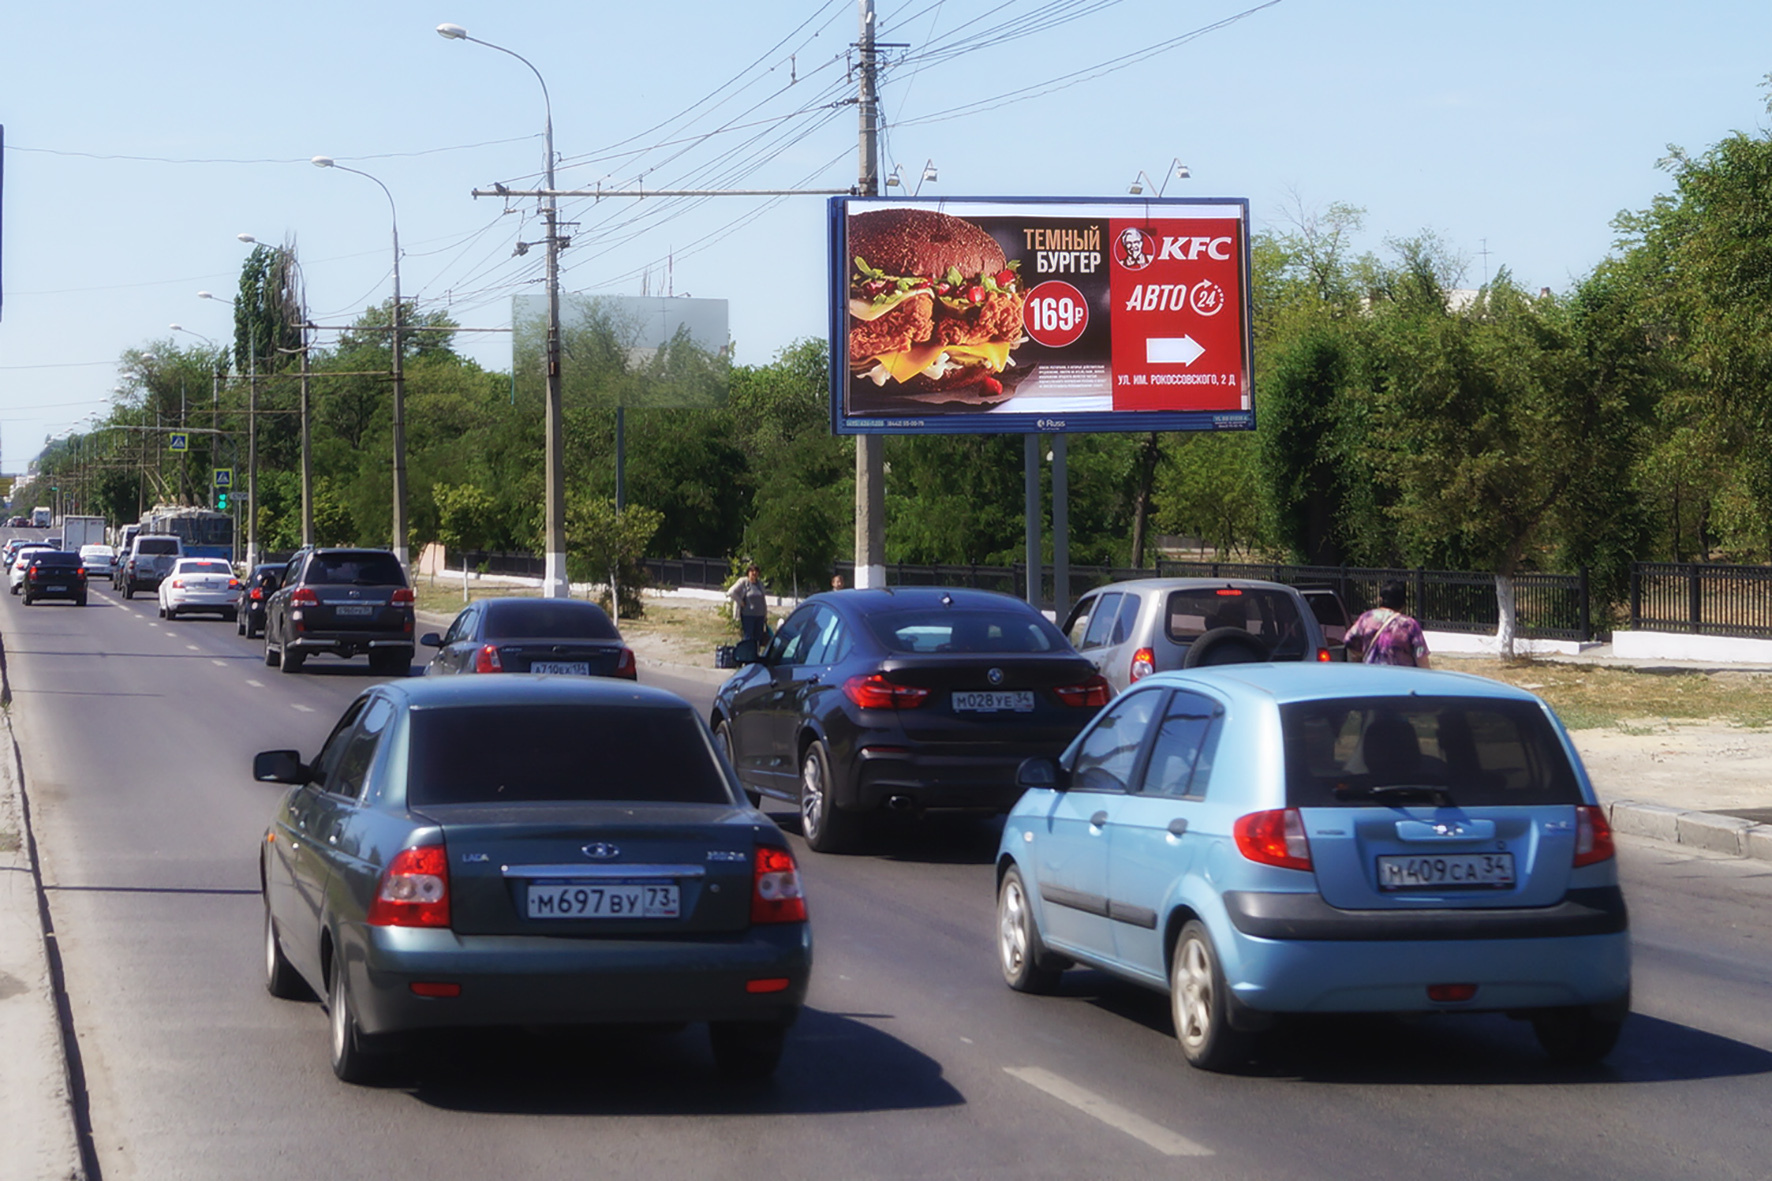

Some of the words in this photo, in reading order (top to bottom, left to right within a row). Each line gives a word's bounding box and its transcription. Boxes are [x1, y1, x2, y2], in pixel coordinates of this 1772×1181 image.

[1023, 225, 1100, 251] ТЕМНЫЙ
[1157, 236, 1232, 260] KFC
[1036, 251, 1101, 273] БУРГЕР
[1125, 284, 1187, 311] АВТО
[1197, 290, 1216, 307] 24
[1221, 374, 1227, 385] 2
[1228, 374, 1236, 386] Д
